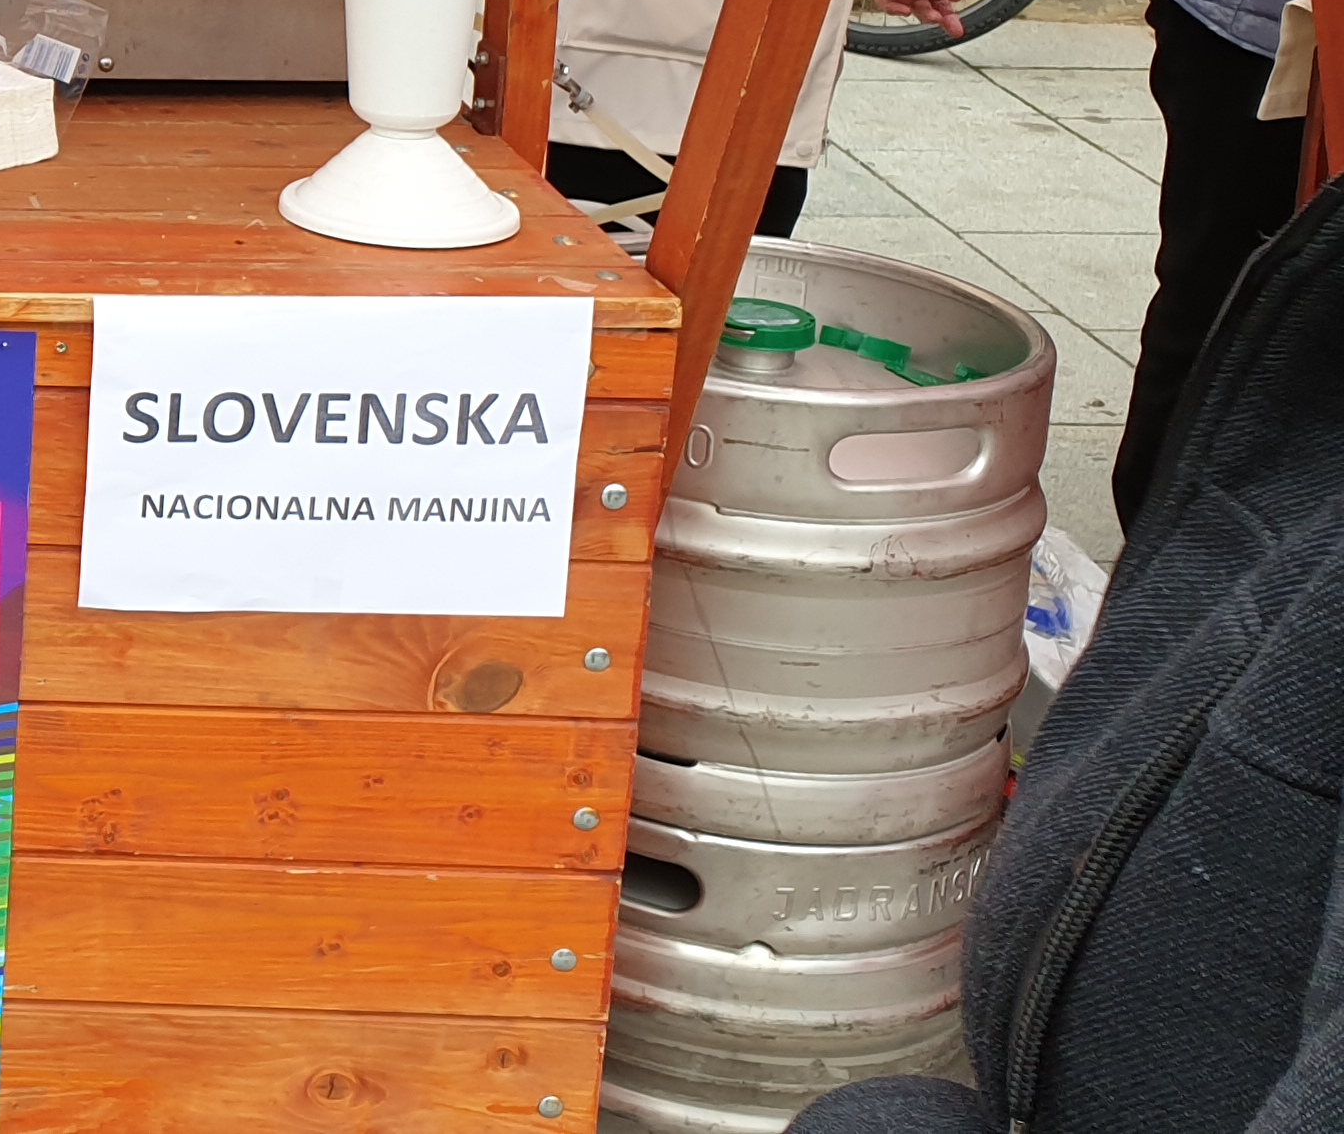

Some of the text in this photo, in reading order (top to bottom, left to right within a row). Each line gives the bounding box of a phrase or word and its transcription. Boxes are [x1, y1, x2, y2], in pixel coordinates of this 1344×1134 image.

[122, 392, 549, 446] SLOVENSKA
[140, 494, 551, 523] NACIONALNA MANJINA
[771, 848, 992, 922] JADRANSK
